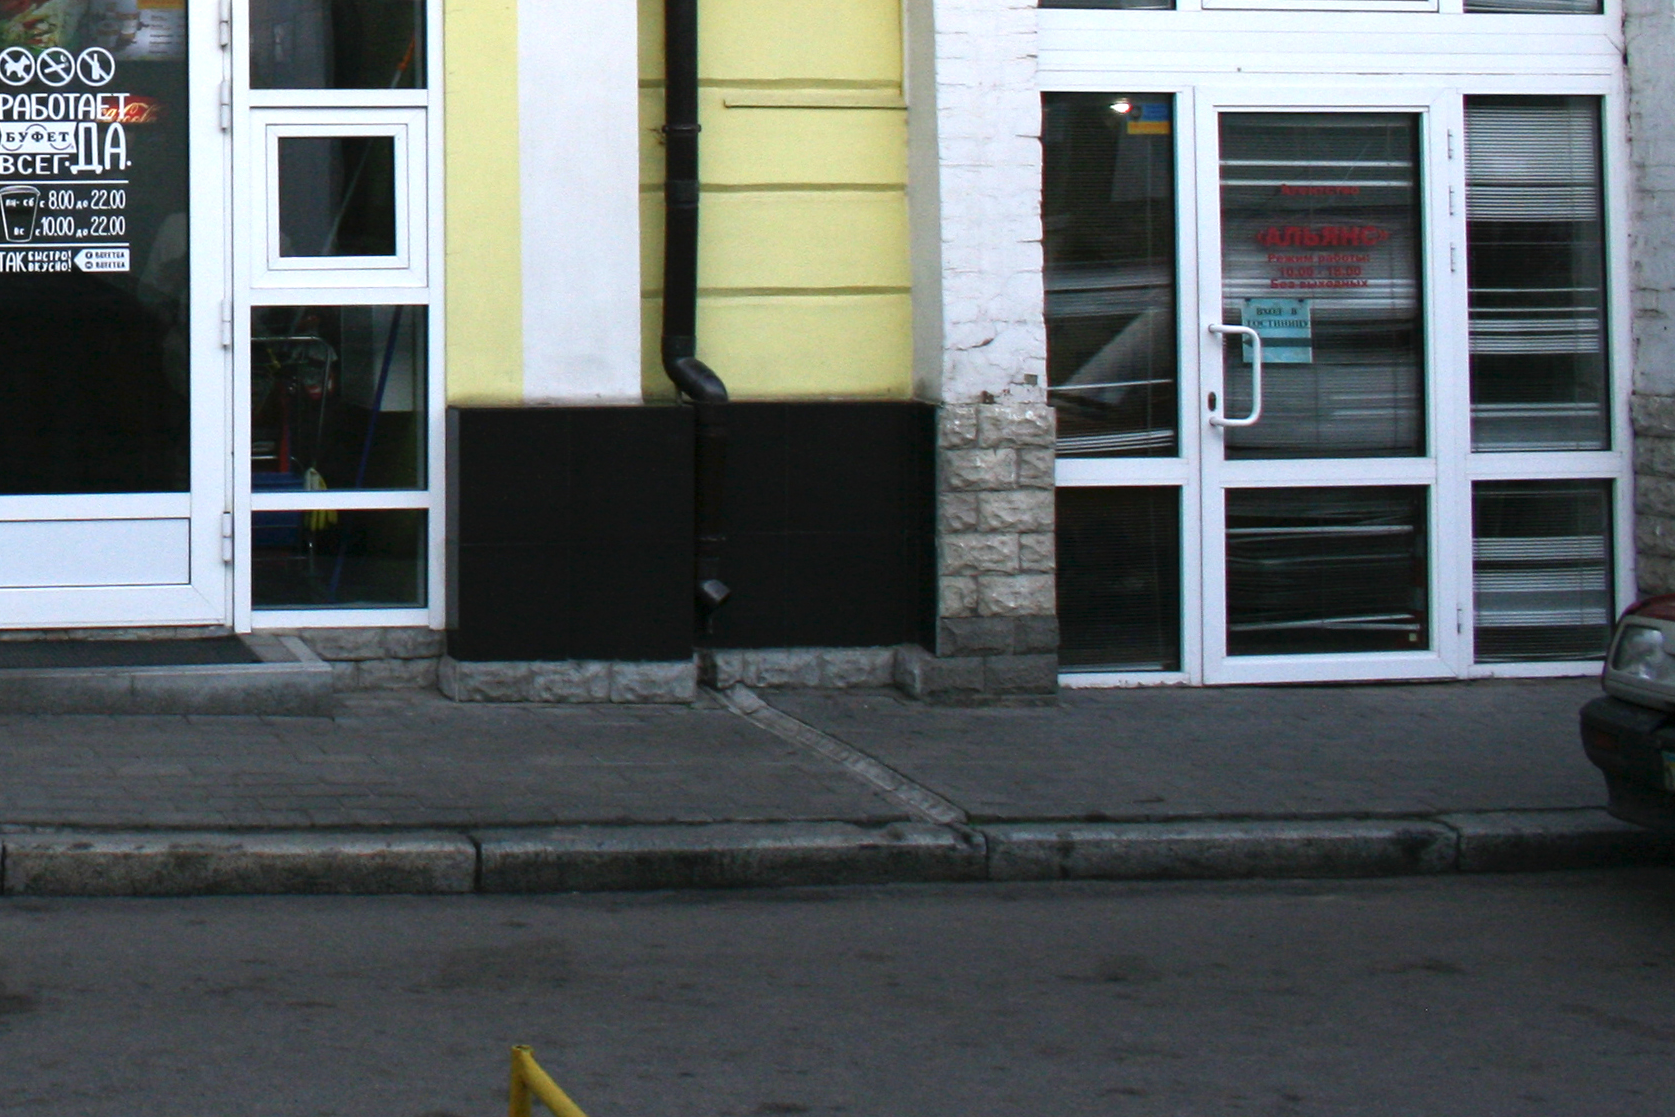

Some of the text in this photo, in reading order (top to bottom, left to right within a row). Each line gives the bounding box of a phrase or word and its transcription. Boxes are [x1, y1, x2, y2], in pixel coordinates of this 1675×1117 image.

[6, 131, 70, 143] БУФЕТ
[48, 190, 75, 210] 8.00
[90, 189, 126, 210] 22.00
[41, 216, 75, 236] 10.00
[90, 216, 126, 236] 22.00
